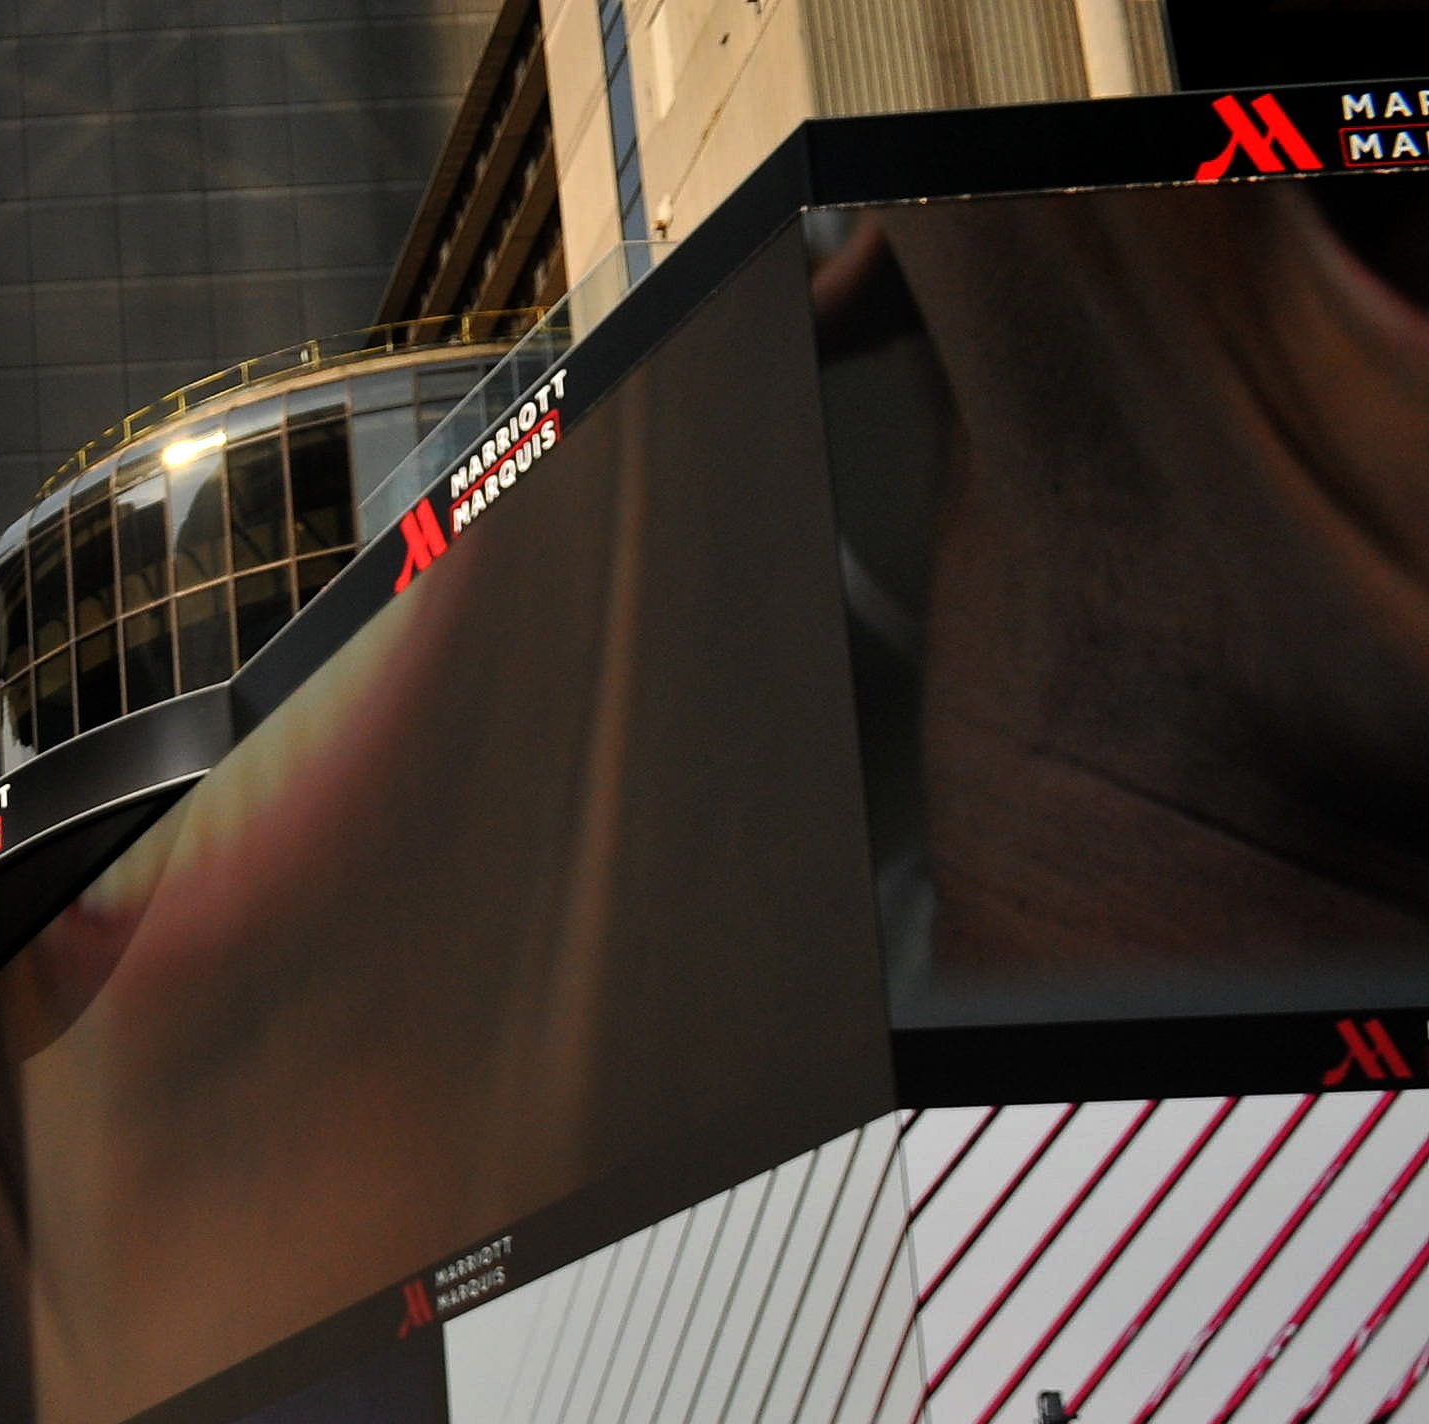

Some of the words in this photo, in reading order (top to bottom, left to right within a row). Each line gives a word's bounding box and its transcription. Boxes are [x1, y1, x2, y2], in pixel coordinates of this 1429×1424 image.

[450, 368, 567, 498] MARRIOTT
[453, 420, 556, 533] MARQUIS
[435, 1235, 513, 1287] MARRIOTT
[437, 1266, 505, 1311] MARQUIS
